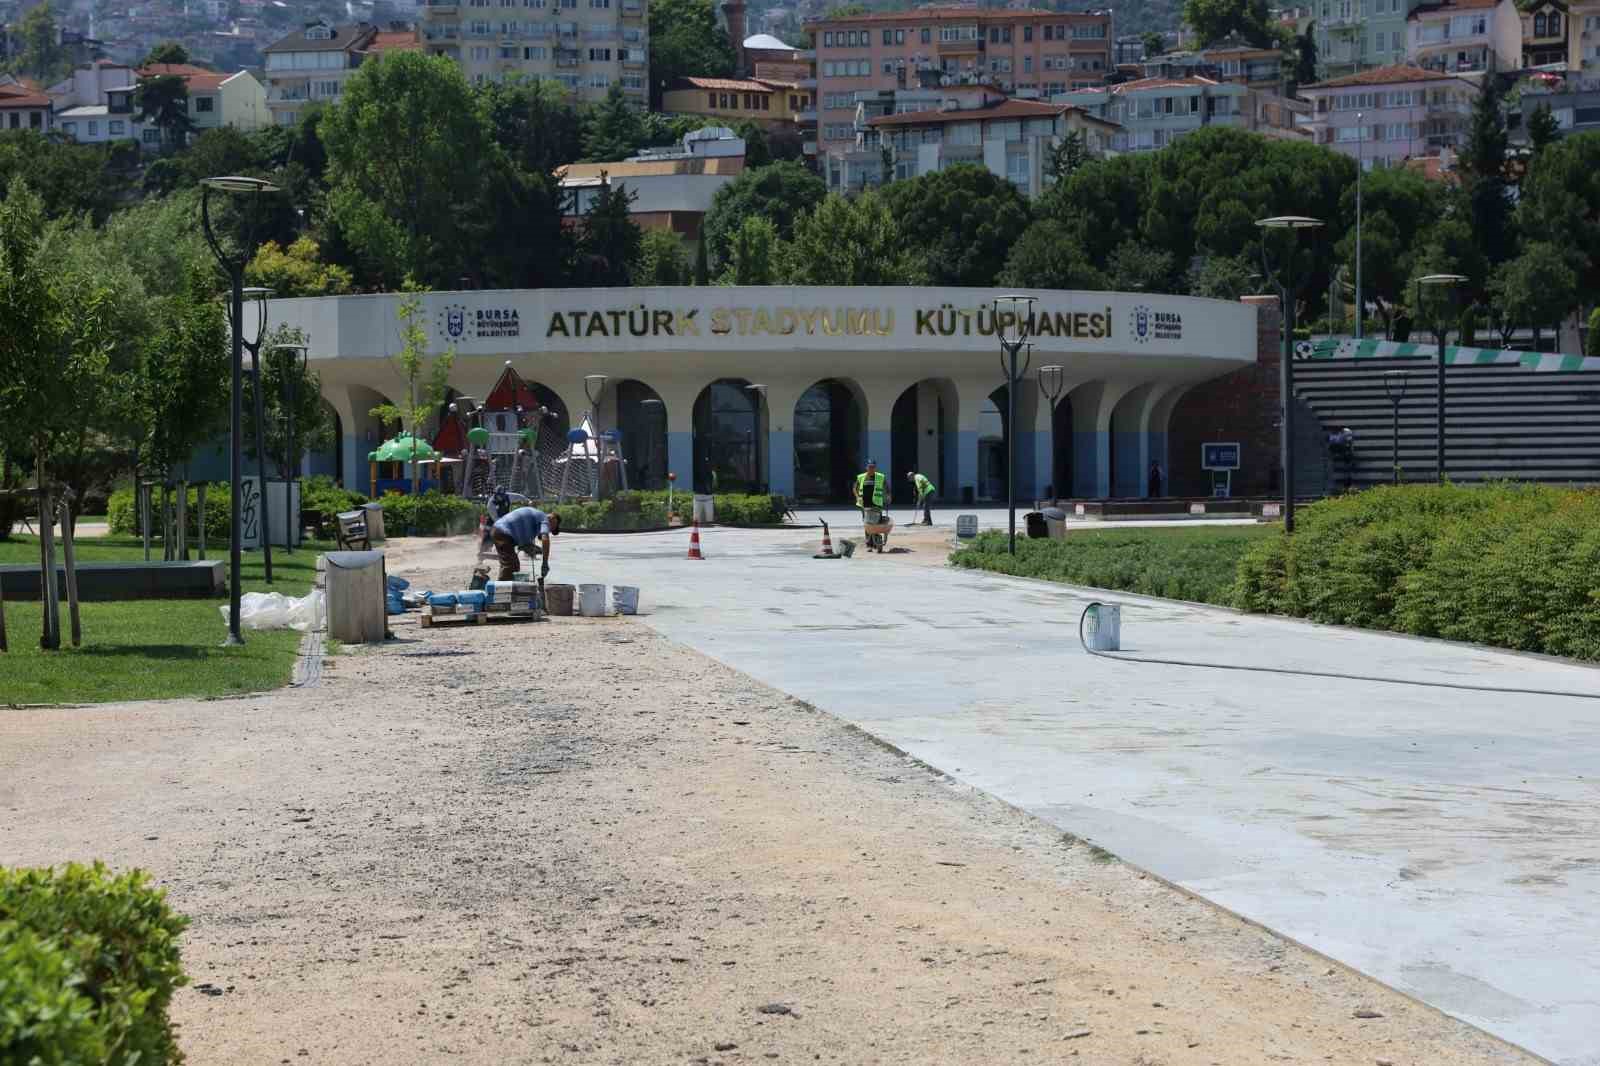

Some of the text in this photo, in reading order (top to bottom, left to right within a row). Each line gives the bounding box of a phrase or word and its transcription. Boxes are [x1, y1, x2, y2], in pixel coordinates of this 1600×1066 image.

[477, 309, 519, 320] BURSA
[1154, 312, 1182, 322] BURSA
[546, 304, 1112, 338] ATATÜRK STADYUMU KÜTÜPHANESİ
